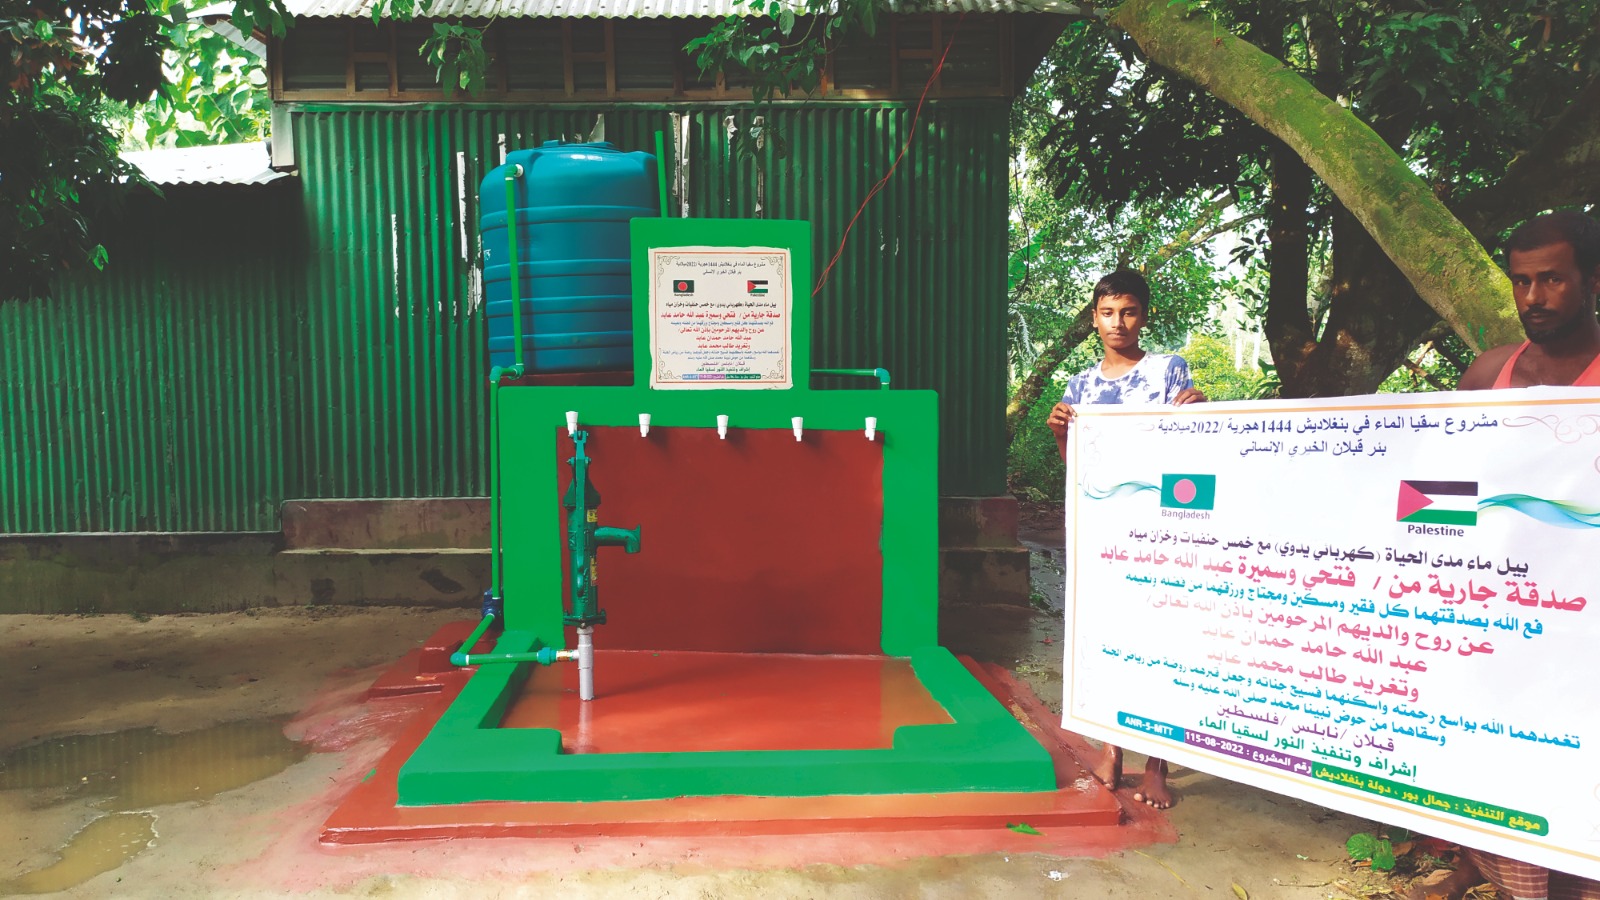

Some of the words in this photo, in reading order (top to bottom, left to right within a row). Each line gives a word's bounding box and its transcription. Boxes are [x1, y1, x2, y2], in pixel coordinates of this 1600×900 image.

[1296, 416, 1348, 434] بنغلاديش
[1352, 415, 1370, 435] في
[1374, 416, 1405, 430] الماء
[1410, 414, 1440, 432] سقيا
[1444, 414, 1498, 434] مشروع
[1332, 438, 1363, 456] قبلان
[1161, 509, 1210, 520] Bangladesh
[1129, 528, 1148, 542] مياه
[1150, 530, 1178, 545] وخزان
[1180, 532, 1219, 547] حنفيات
[1408, 524, 1464, 537] Palestine
[1222, 536, 1254, 550] خمس
[1257, 541, 1271, 555] مع
[1101, 545, 1129, 564] عابد
[1134, 550, 1169, 565] حامد
[1174, 552, 1198, 568] الله
[1385, 547, 1427, 566] الحياة
[1431, 553, 1463, 568] مدى
[1467, 555, 1492, 570] ماء
[1203, 558, 1234, 577] عبد
[1238, 555, 1296, 586] وسميرة
[1496, 557, 1529, 578] بيل
[1302, 565, 1356, 591] فتحي
[1388, 574, 1422, 598] من
[1248, 586, 1288, 605] ومحتاج
[1428, 574, 1498, 609] جارية
[1505, 580, 1587, 612] صدقة
[1290, 591, 1344, 612] ومسكين
[1348, 598, 1375, 616] فقير
[1379, 603, 1409, 618] كل
[1258, 607, 1332, 632] المرحومين
[1414, 606, 1489, 632] بصدقتهما
[1492, 612, 1518, 631] الله
[1241, 630, 1294, 648] حمدان
[1337, 622, 1409, 646] والديهم
[1414, 632, 1452, 652] روح
[1301, 641, 1347, 657] حامد
[1352, 644, 1383, 664] الله
[1458, 636, 1494, 656] عن
[1247, 656, 1294, 674] محمد
[1389, 654, 1427, 674] عبد
[1299, 665, 1347, 683] طالب
[1256, 676, 1287, 693] جناته
[1290, 684, 1322, 698] فسيح
[1353, 676, 1419, 702] وتغريد
[1270, 698, 1300, 710] محمد
[1326, 690, 1388, 714] واسكنهما
[1304, 703, 1331, 720] نبينا
[1334, 710, 1366, 726] حوض
[1392, 704, 1435, 724] رحمته
[1199, 716, 1226, 731] الماء
[1232, 722, 1268, 742] لسقيا
[1370, 718, 1387, 731] من
[1439, 714, 1477, 734] بواسع
[1481, 718, 1504, 735] الله
[1185, 732, 1244, 754] 115-08-2022
[1274, 736, 1304, 750] النور
[1392, 722, 1446, 746] وسقاهما
[1510, 725, 1580, 749] تغمدهما
[1353, 734, 1394, 754] قبلان
[1252, 751, 1290, 766] المشروع
[1311, 742, 1362, 767] وتنفيذ
[1294, 762, 1311, 774] رقم
[1368, 756, 1416, 782] إشراف
[1315, 767, 1364, 788] بنغلاديش
[1367, 780, 1391, 793] دولة
[1402, 791, 1419, 802] بور
[1422, 794, 1450, 809] جمال
[1464, 803, 1505, 821] التنفيذ
[1508, 816, 1540, 831] موقع
